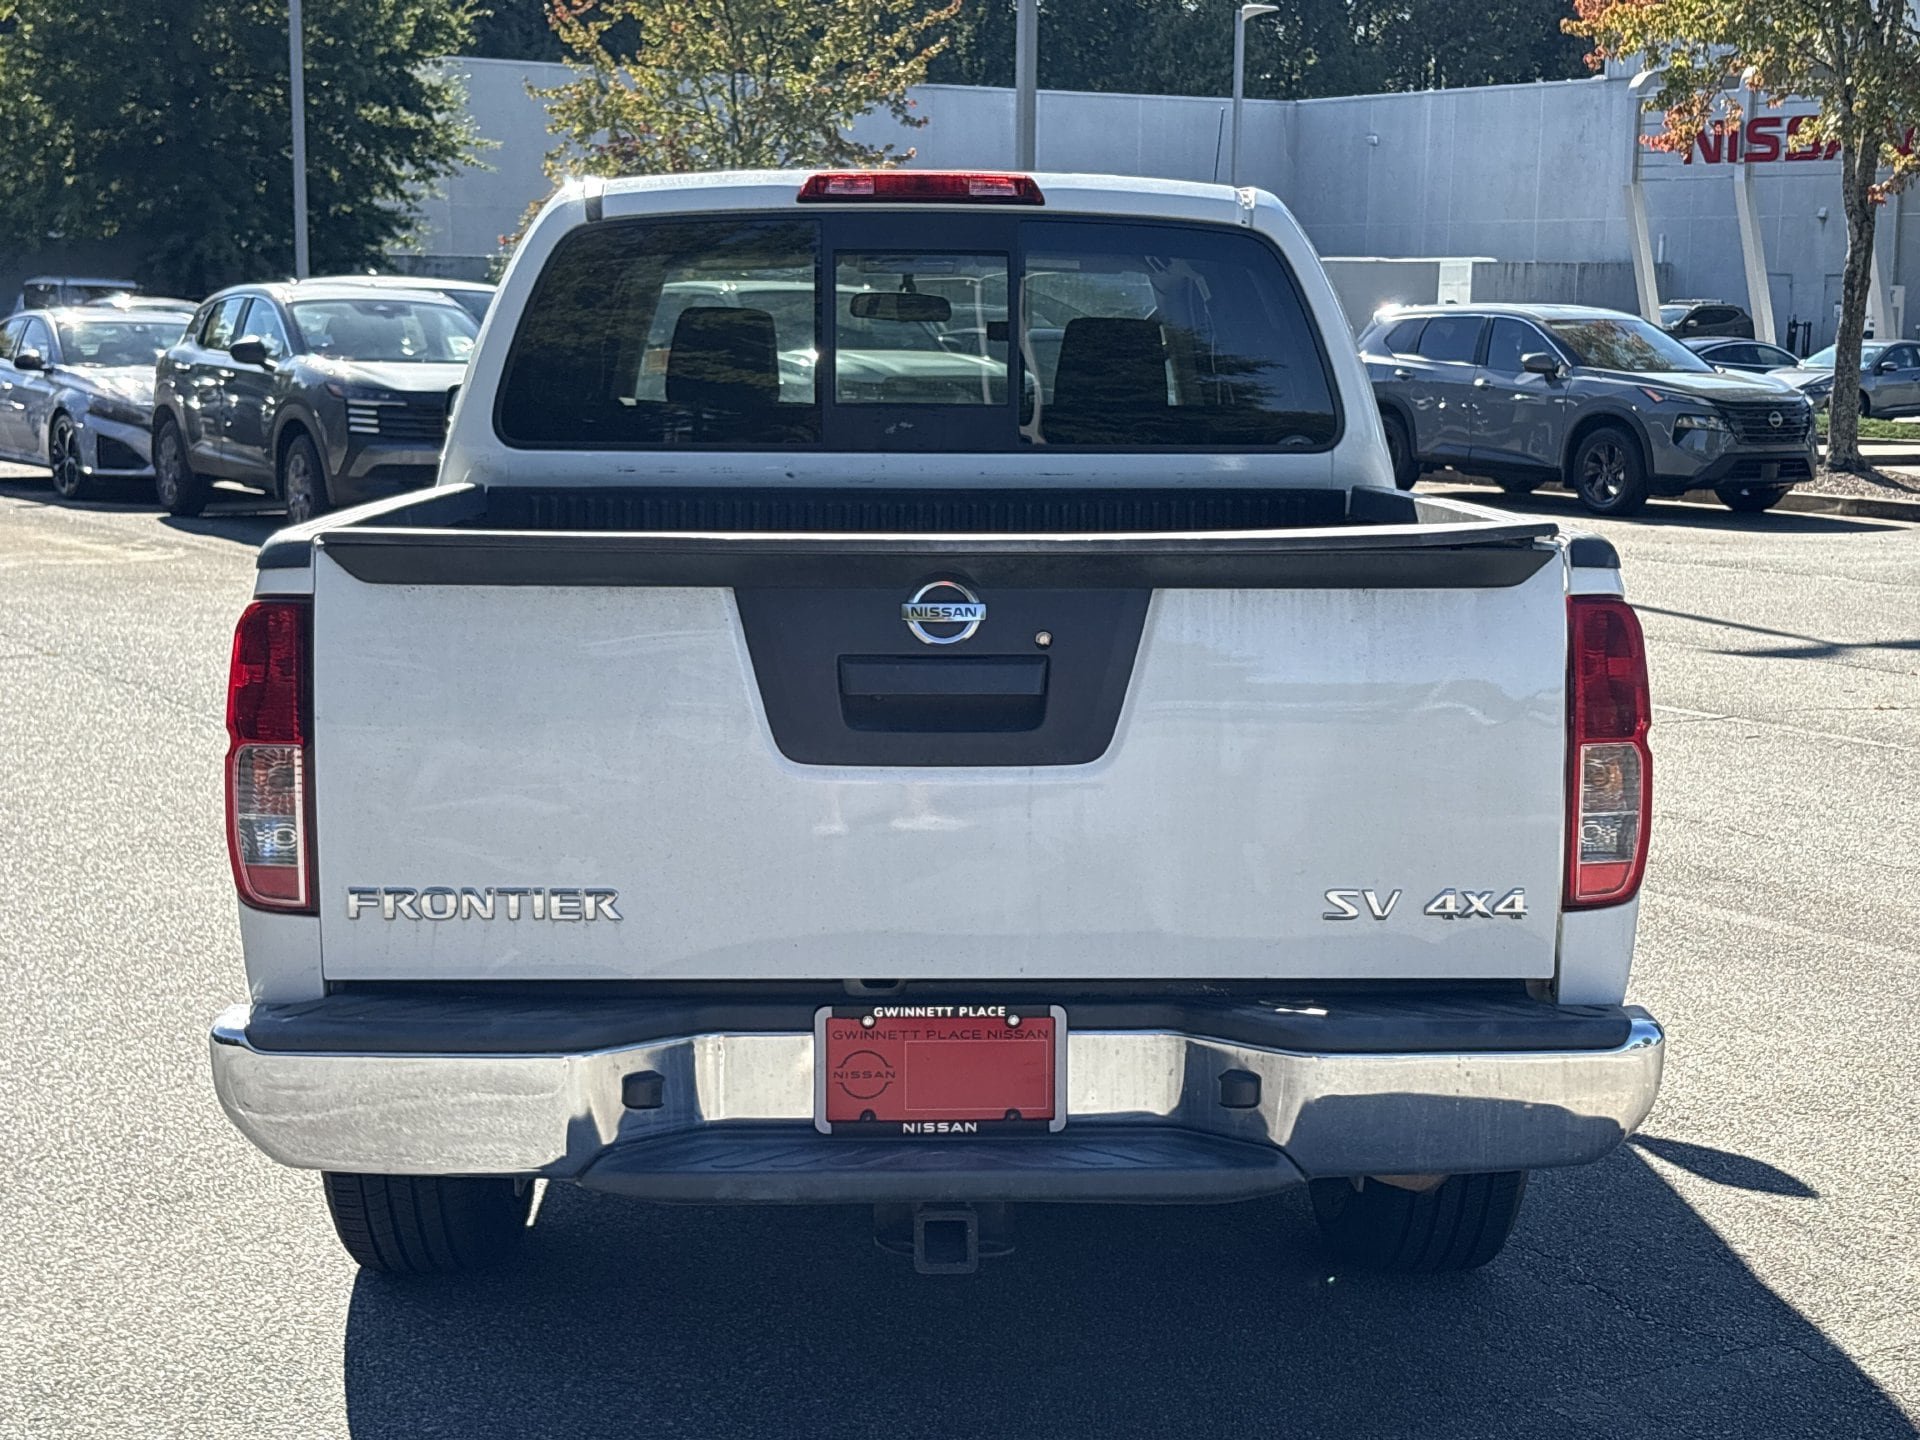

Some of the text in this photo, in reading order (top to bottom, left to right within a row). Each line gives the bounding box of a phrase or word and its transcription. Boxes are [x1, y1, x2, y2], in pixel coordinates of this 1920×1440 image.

[910, 606, 977, 618] NISSAN
[347, 886, 623, 920] FRONTIER
[1322, 888, 1402, 920] SV
[873, 1006, 1006, 1018] GWINNETT PLACE
[832, 1029, 1049, 1041] GWINNETT PLACE NISSAN
[833, 1070, 896, 1079] NISSAN
[903, 1122, 977, 1133] NISSAN
